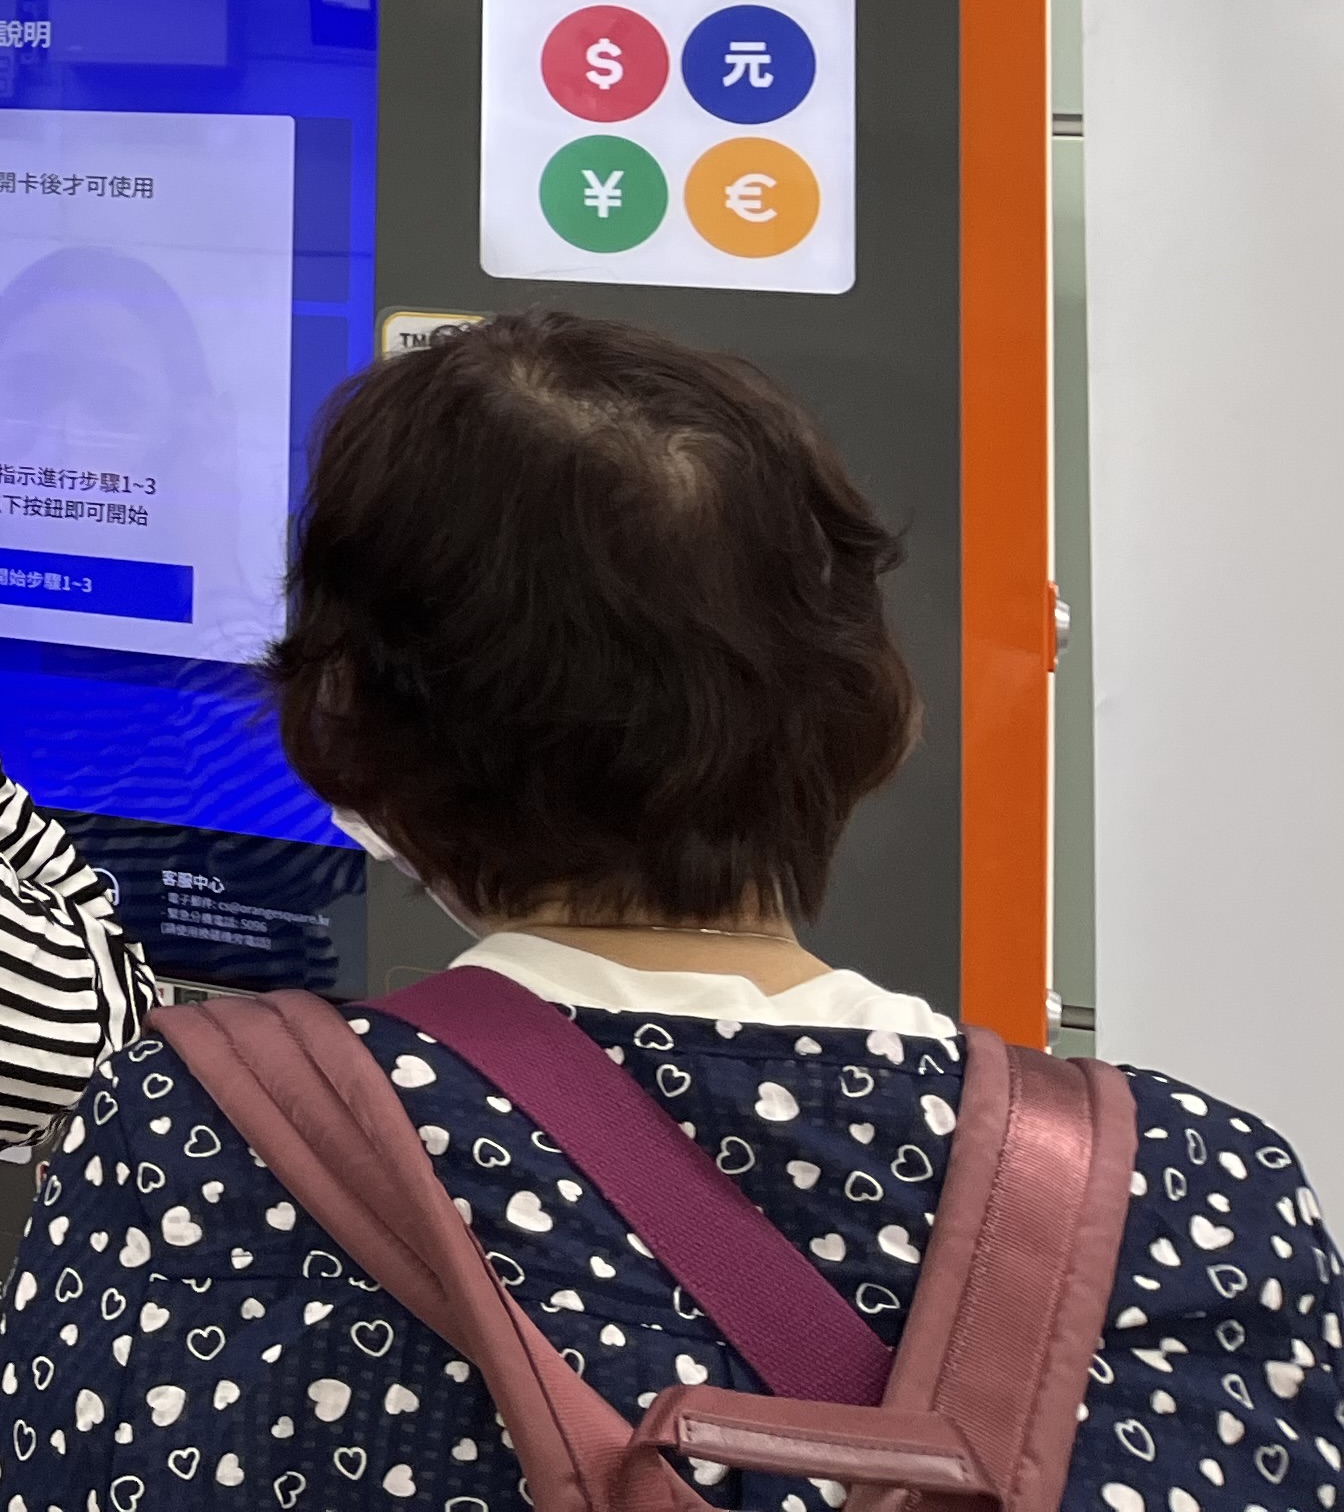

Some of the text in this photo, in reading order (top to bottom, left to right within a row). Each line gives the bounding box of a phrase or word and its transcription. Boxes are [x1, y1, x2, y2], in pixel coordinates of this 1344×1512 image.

[585, 38, 774, 90] $ 元
[582, 170, 778, 223] ¥ €
